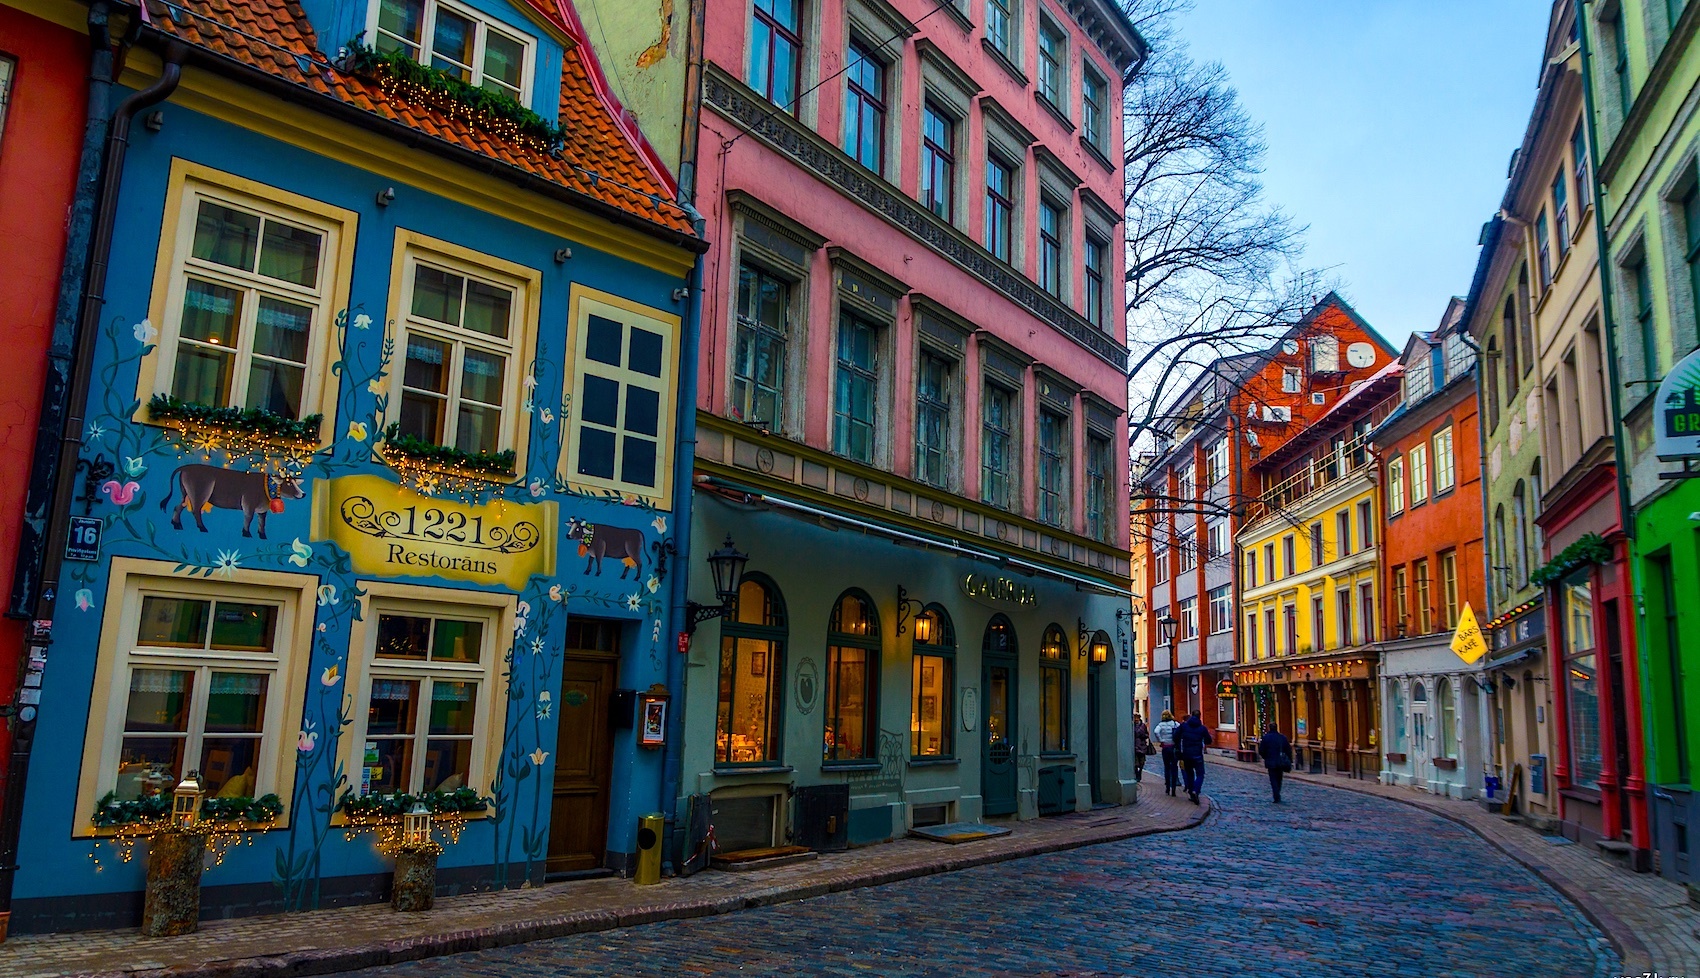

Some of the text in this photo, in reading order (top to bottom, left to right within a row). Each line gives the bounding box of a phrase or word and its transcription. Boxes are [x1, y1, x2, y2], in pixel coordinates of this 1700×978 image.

[74, 525, 97, 545] 16
[402, 505, 486, 546] 1221
[385, 543, 498, 575] Restorāns
